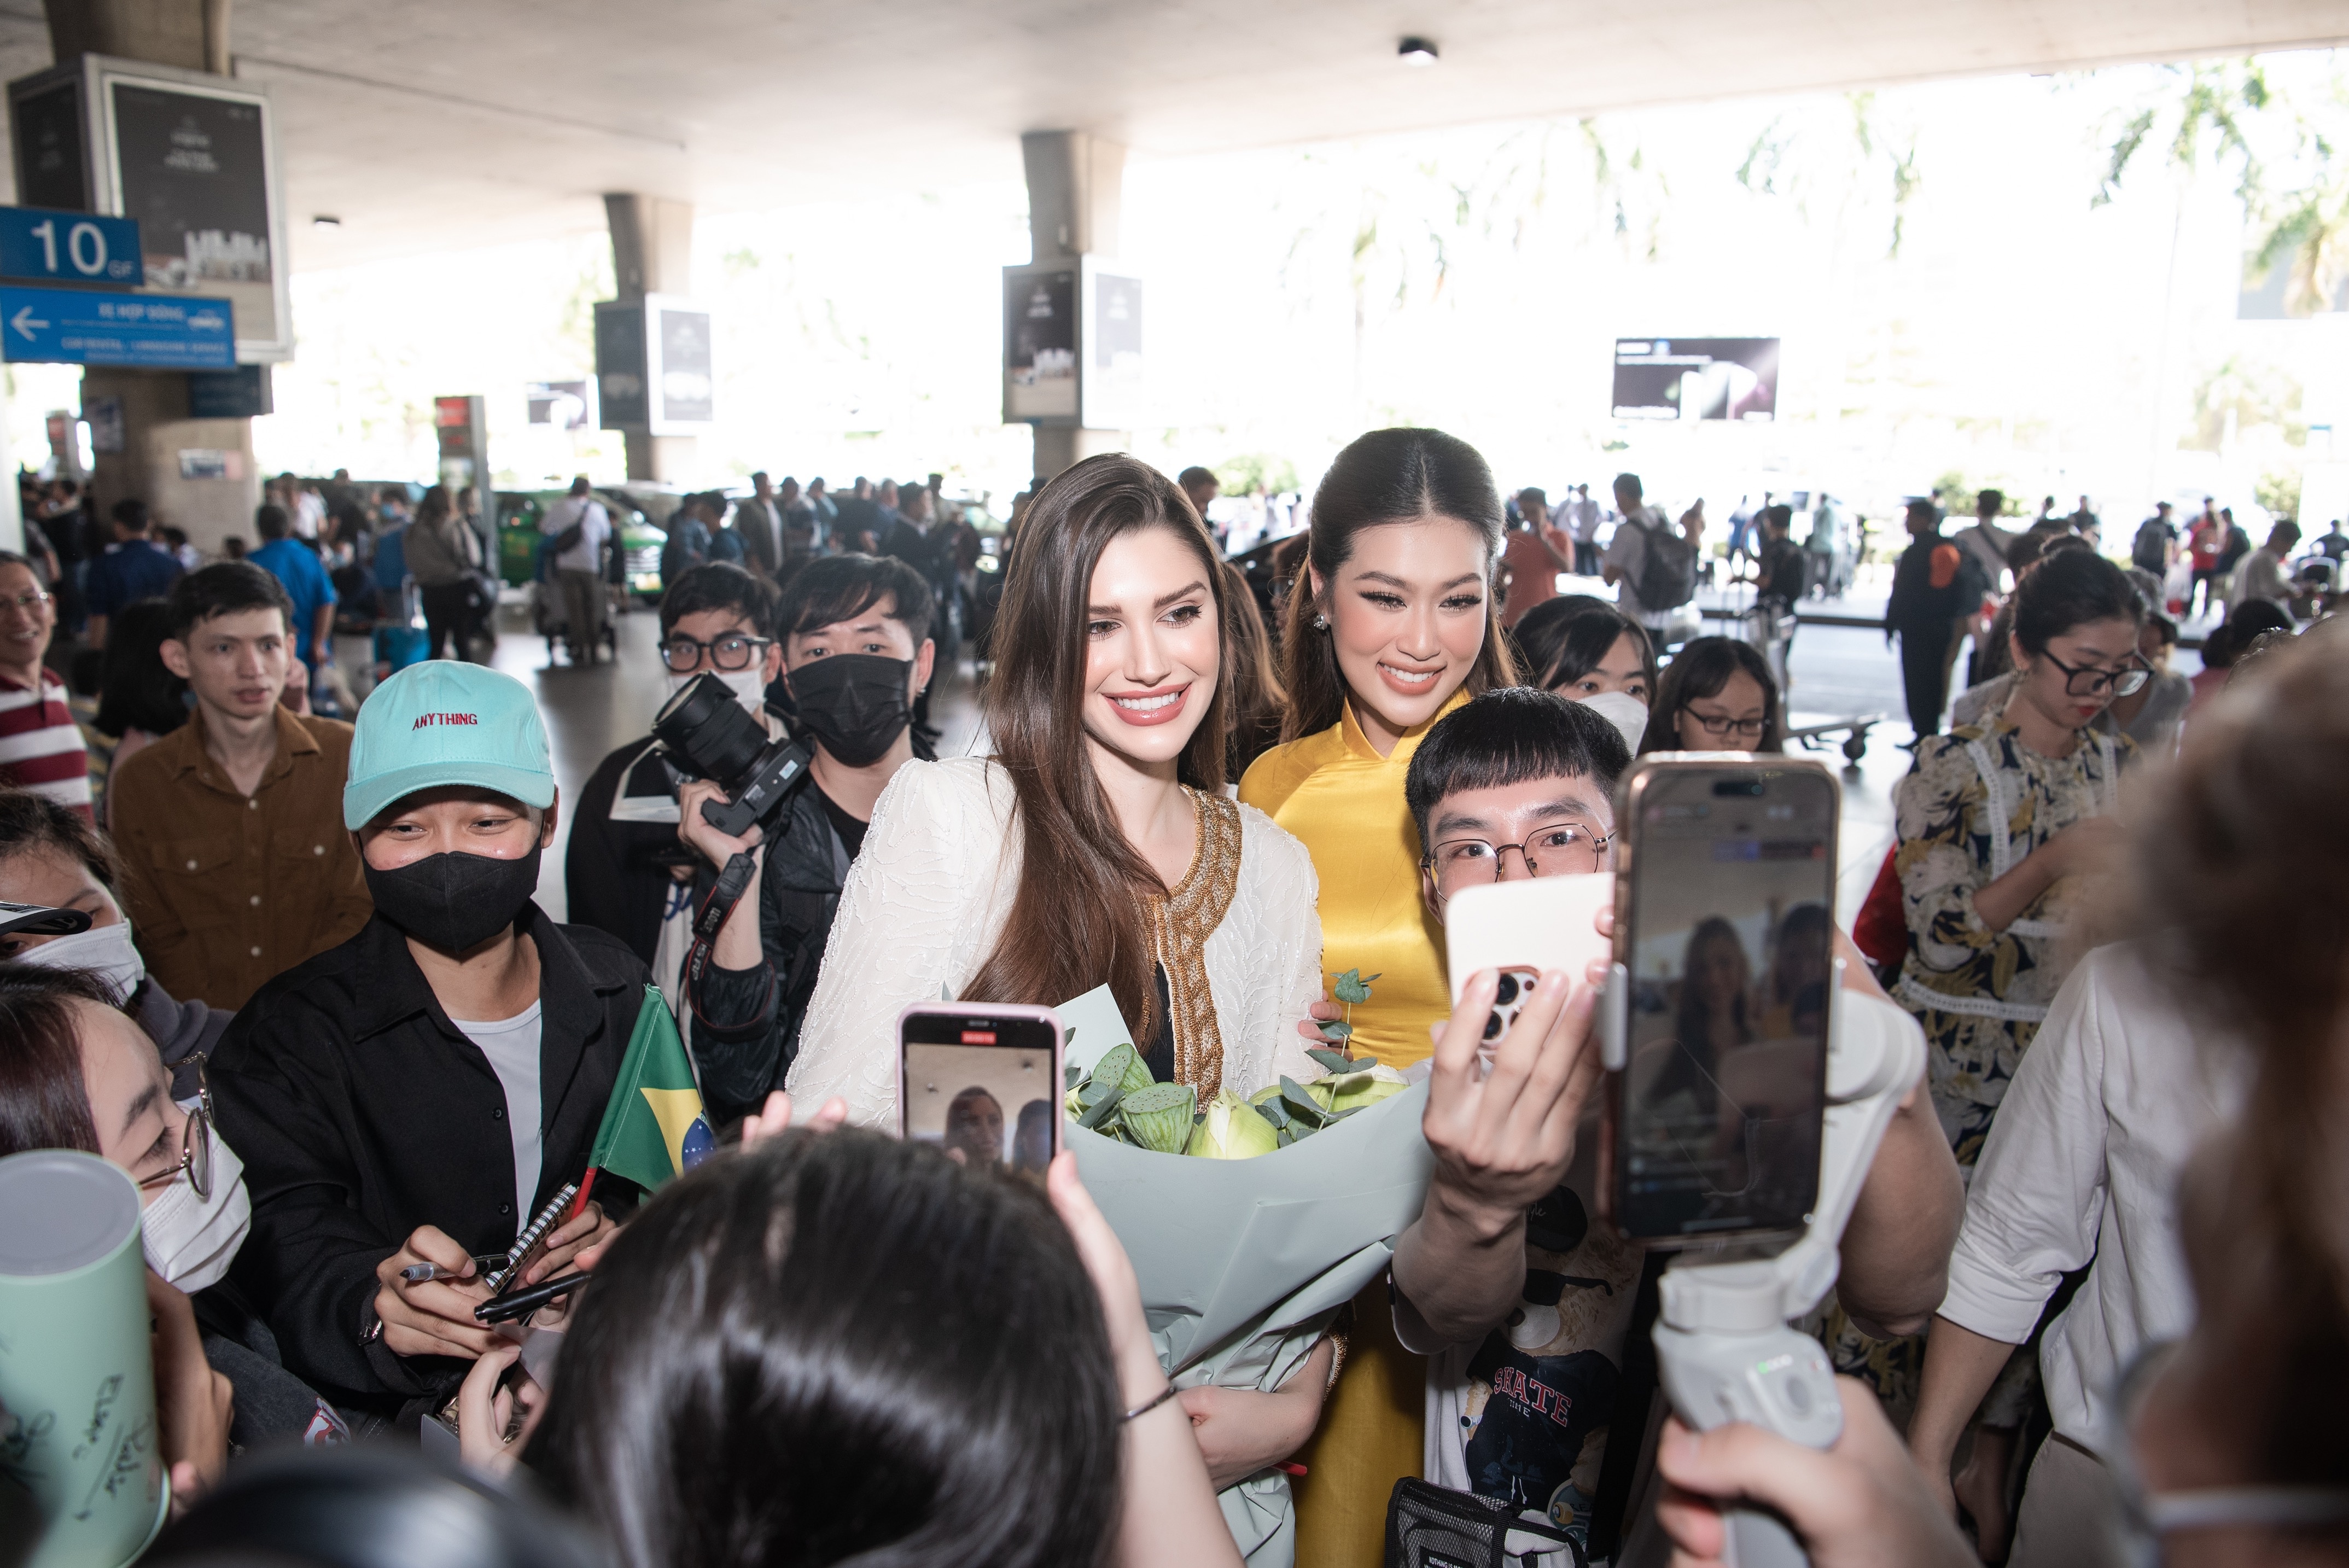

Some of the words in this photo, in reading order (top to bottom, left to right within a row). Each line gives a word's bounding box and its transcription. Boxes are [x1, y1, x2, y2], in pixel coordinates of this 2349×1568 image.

[31, 220, 108, 276] 10
[412, 713, 477, 731] ANYTHING
[1494, 1367, 1572, 1427] SKATE
[1508, 1397, 1531, 1418] TIME
[1429, 1555, 1448, 1568] NOTHING
